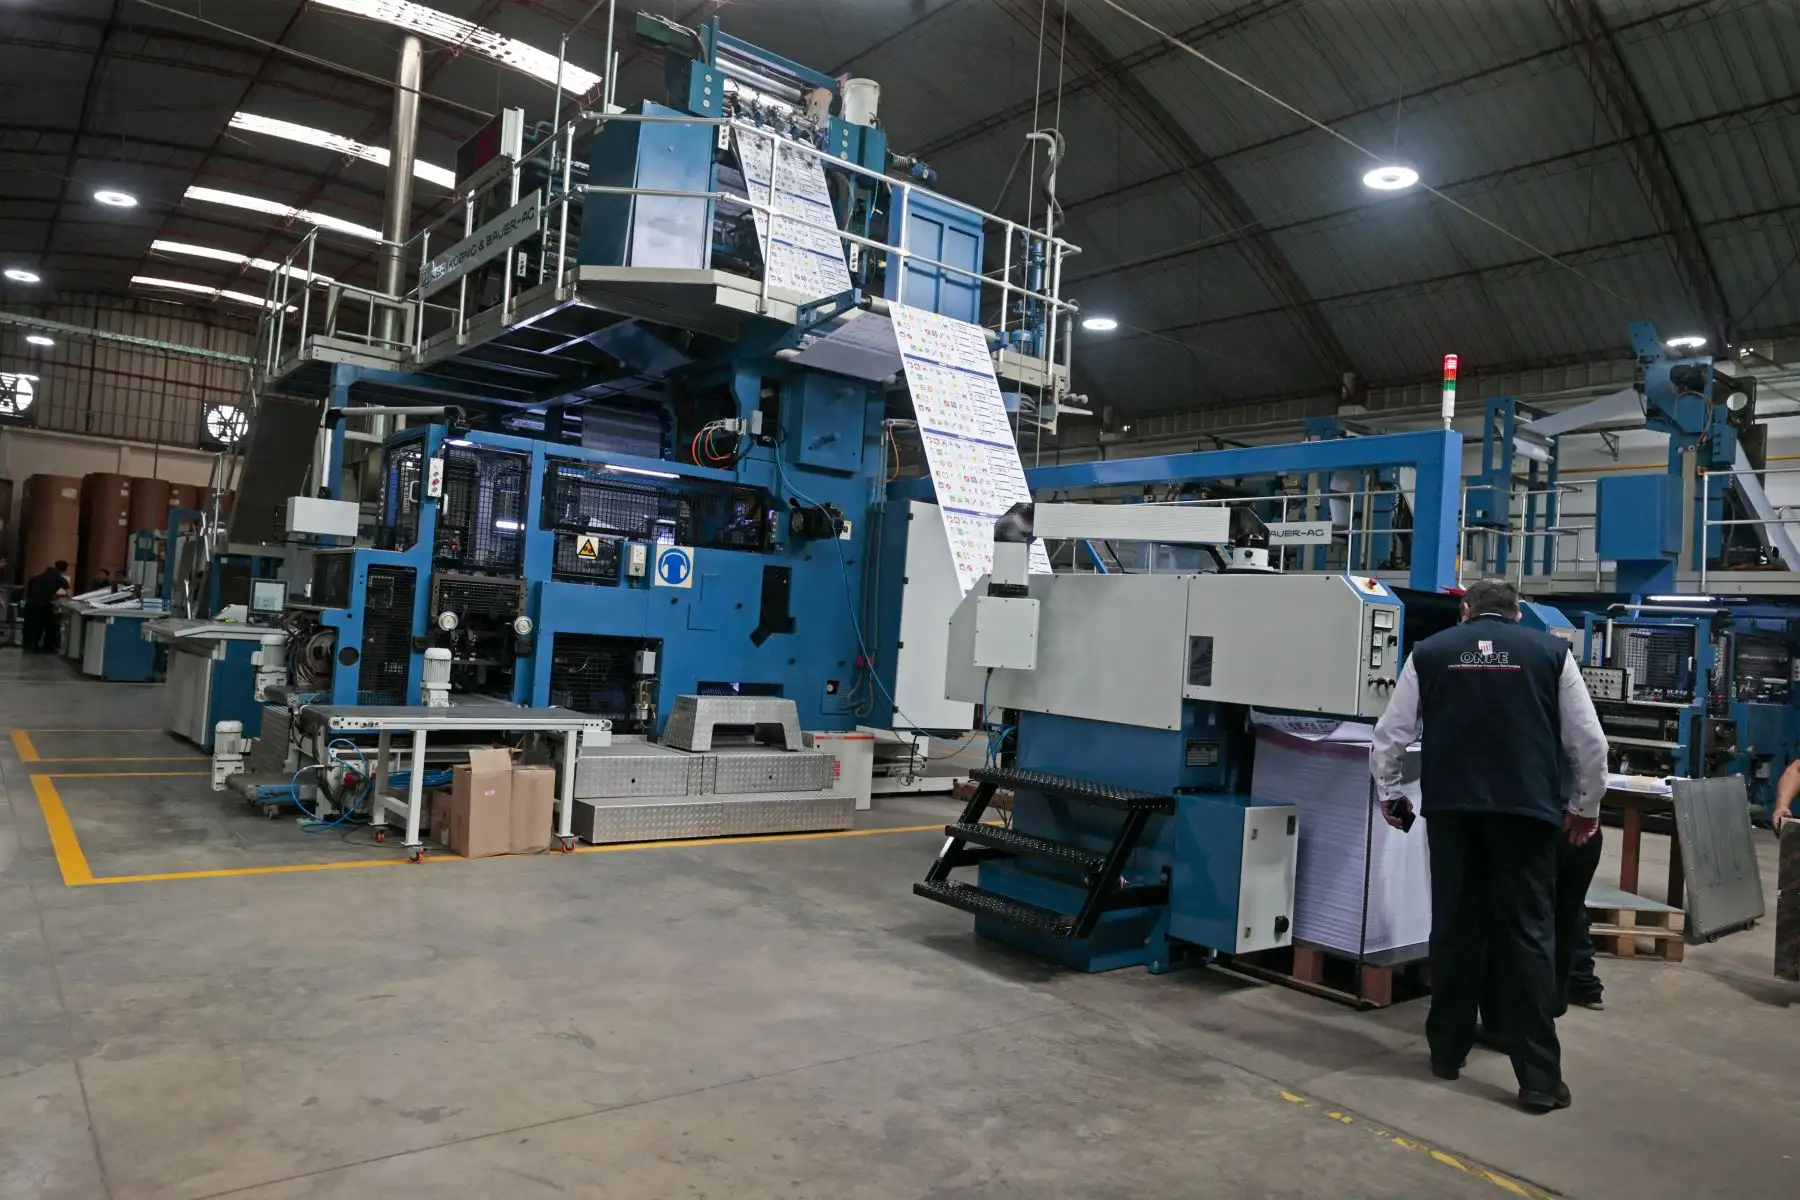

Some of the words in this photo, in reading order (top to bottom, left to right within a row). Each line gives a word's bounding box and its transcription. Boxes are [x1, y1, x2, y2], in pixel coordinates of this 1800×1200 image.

[446, 244, 477, 271] KOENIG
[478, 240, 485, 252] &
[486, 206, 535, 247] BAUER-AG
[1269, 529, 1324, 537] AUER-AG
[1460, 652, 1508, 664] ONPE
